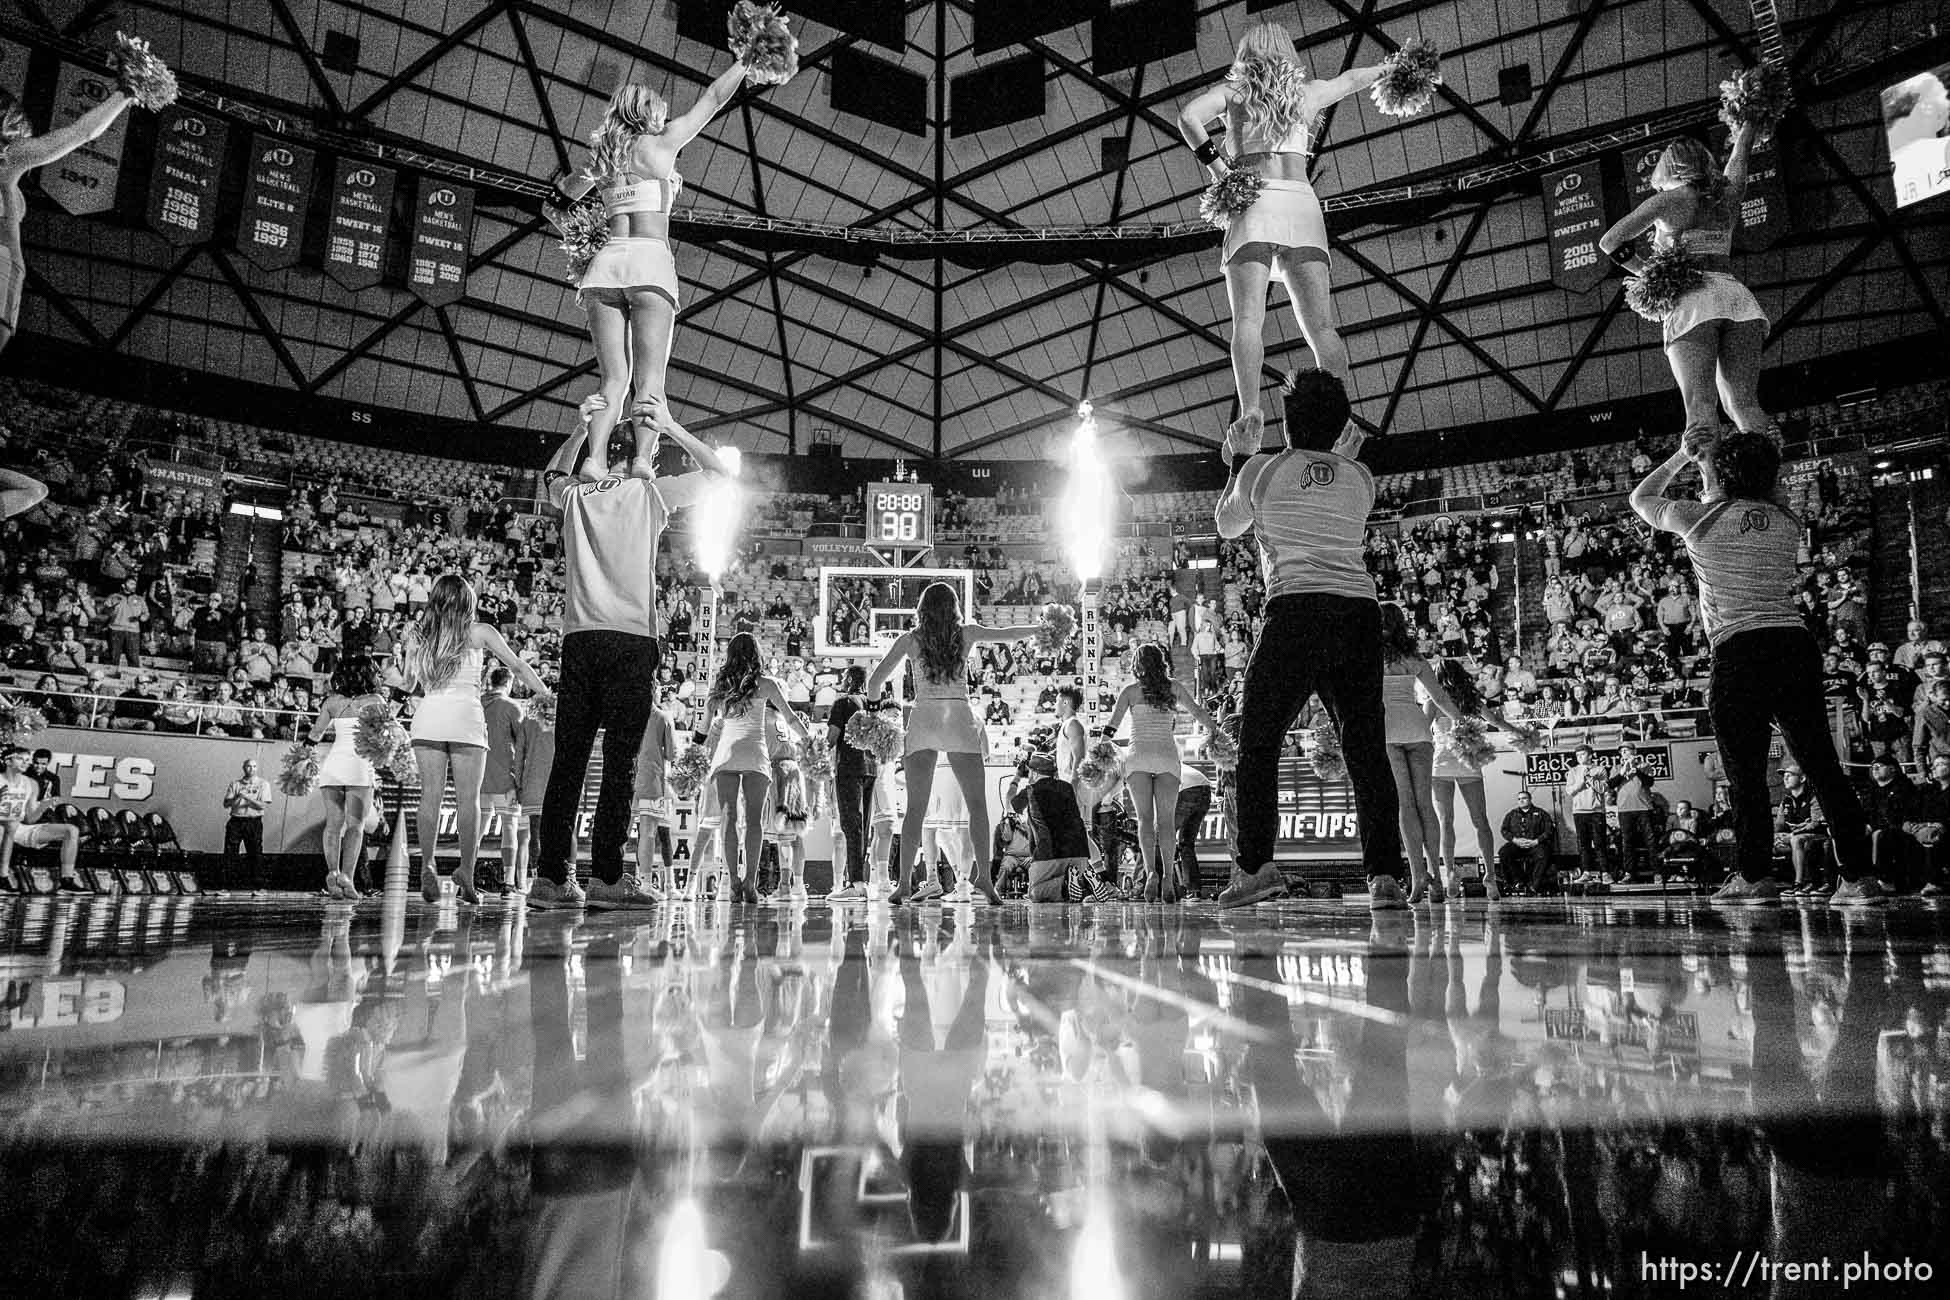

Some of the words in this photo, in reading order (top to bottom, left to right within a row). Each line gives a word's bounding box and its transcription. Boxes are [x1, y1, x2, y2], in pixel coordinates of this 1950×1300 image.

[166, 165, 198, 184] FINAL
[256, 174, 300, 193] BASKETBALL
[168, 187, 199, 206] 1961
[257, 195, 285, 210] ELITE
[340, 196, 382, 213] BASKETBALL
[1554, 200, 1595, 216] BASKETBALL
[160, 209, 198, 230] 1998
[336, 216, 371, 230] SWEET
[423, 215, 462, 231] BASKETBALL
[1554, 221, 1588, 238] SWEET
[1589, 218, 1600, 228] 16
[253, 231, 288, 248] 1997
[419, 234, 452, 248] SWEET
[1564, 241, 1595, 259] 2001
[1564, 253, 1598, 271] 2006
[149, 467, 214, 487] MNASTICS
[699, 605, 710, 681] RUNNIN
[1087, 610, 1097, 684] RUNNIN
[697, 699, 705, 721] UT
[1088, 701, 1097, 723] UT
[1529, 755, 1573, 772] Jack
[48, 752, 156, 801] TES
[1529, 772, 1562, 783] HEAD
[1279, 813, 1358, 839] NE-UPS
[673, 808, 692, 890] TAH
